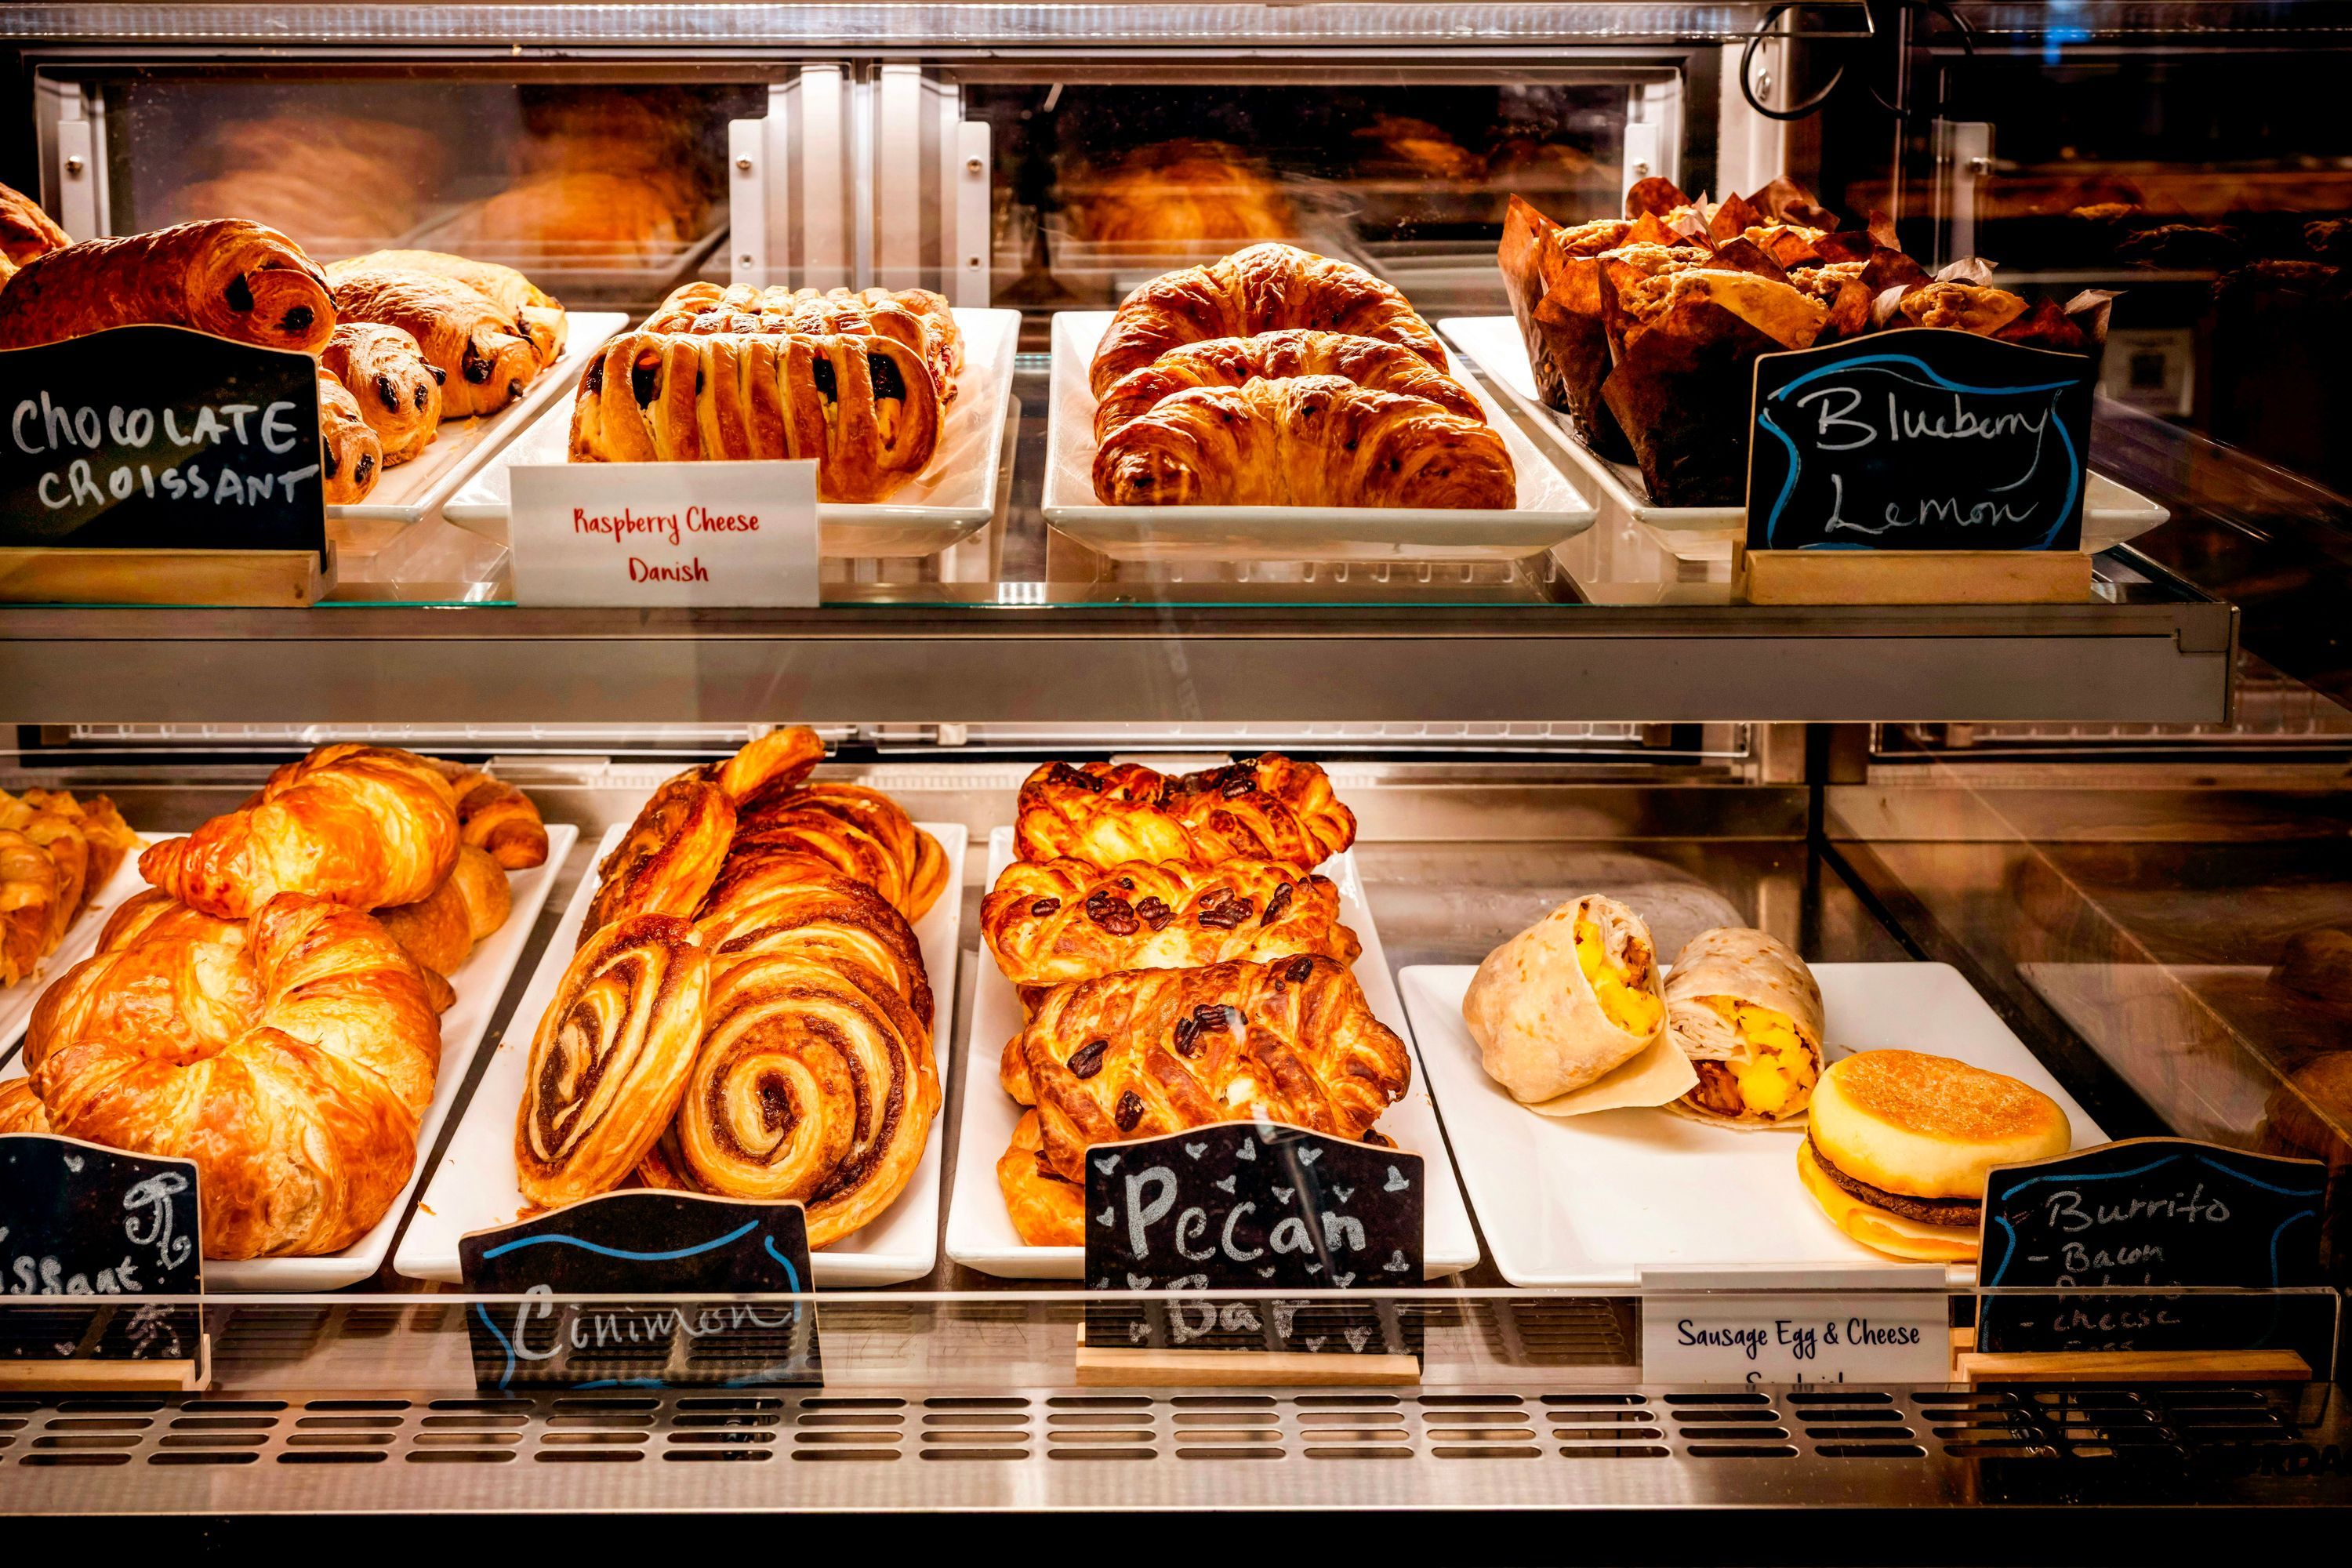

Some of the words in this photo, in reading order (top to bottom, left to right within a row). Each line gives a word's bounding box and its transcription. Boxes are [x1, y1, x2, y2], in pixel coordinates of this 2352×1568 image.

[38, 459, 320, 510] CROISSANT
[1825, 474, 2039, 534] Lemon
[573, 507, 679, 546] Raspberry
[686, 506, 760, 532] Cheese
[629, 557, 710, 583] Danish
[2045, 1183, 2230, 1232] Burrito
[2061, 1242, 2165, 1272] Bacon
[1165, 1273, 1310, 1345] Bar
[1678, 1319, 1768, 1360] Sausage
[1775, 1319, 1817, 1360] Egg
[1823, 1322, 1839, 1345] &
[1847, 1317, 1921, 1345] Cheese
